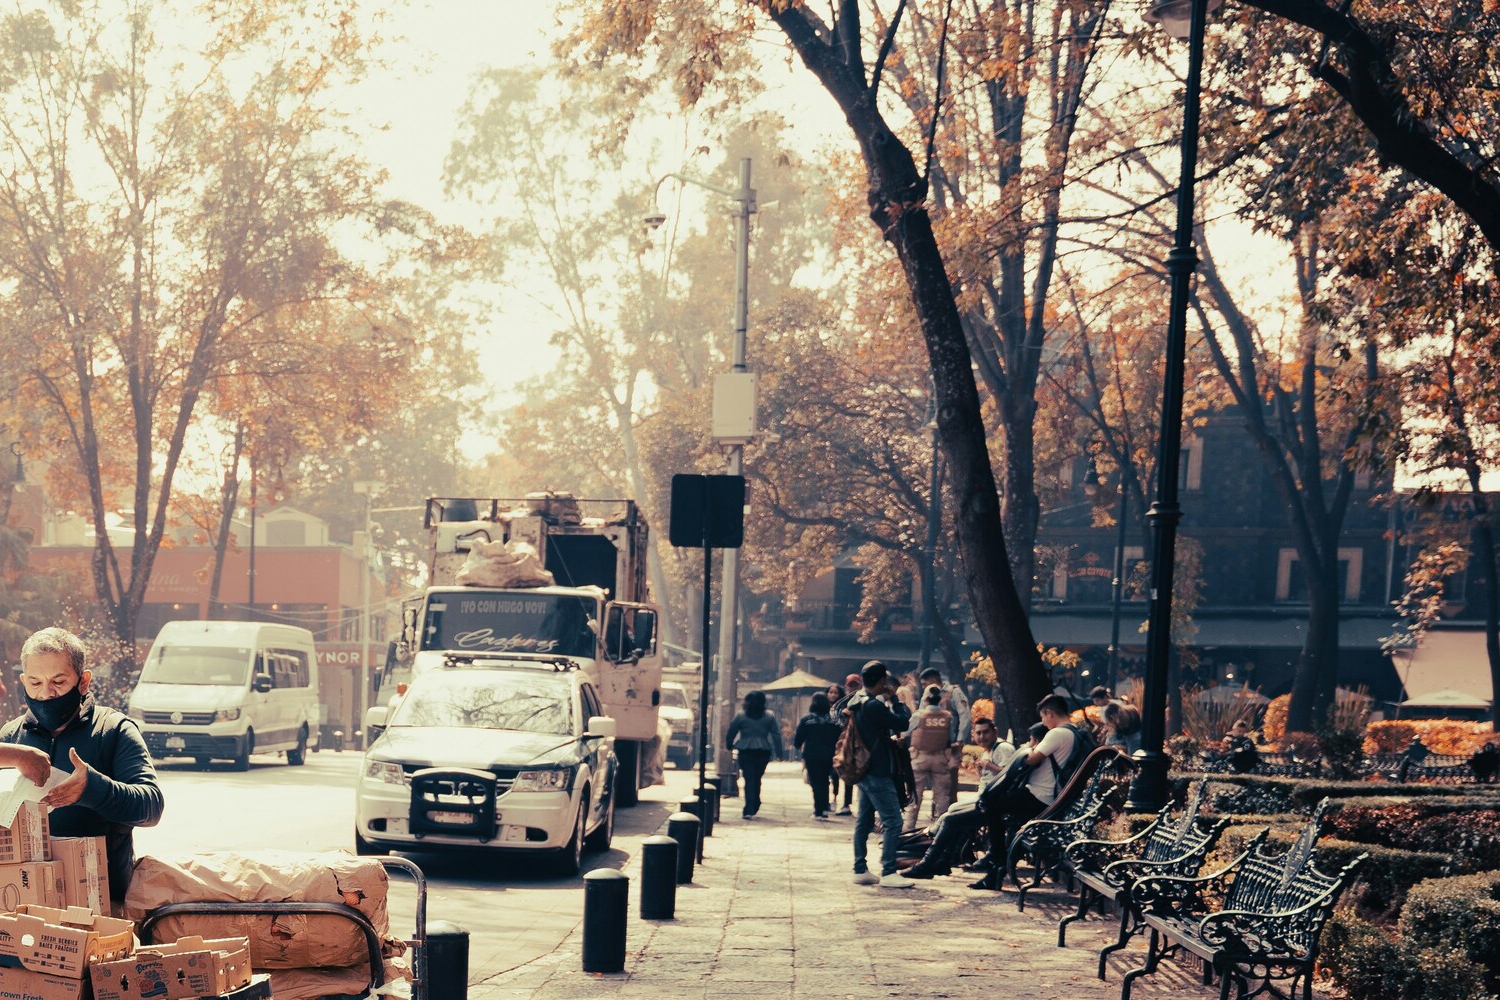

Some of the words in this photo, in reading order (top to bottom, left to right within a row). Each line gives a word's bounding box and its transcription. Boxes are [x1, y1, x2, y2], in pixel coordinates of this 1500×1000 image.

[476, 600, 497, 614] CON
[497, 600, 521, 614] HUGO
[524, 601, 547, 615] VOY!
[925, 718, 946, 727] SSC
[39, 941, 53, 950] BAIES
[41, 934, 56, 942] FRESH
[58, 937, 78, 946] BERRIES
[135, 961, 164, 973] Berries
